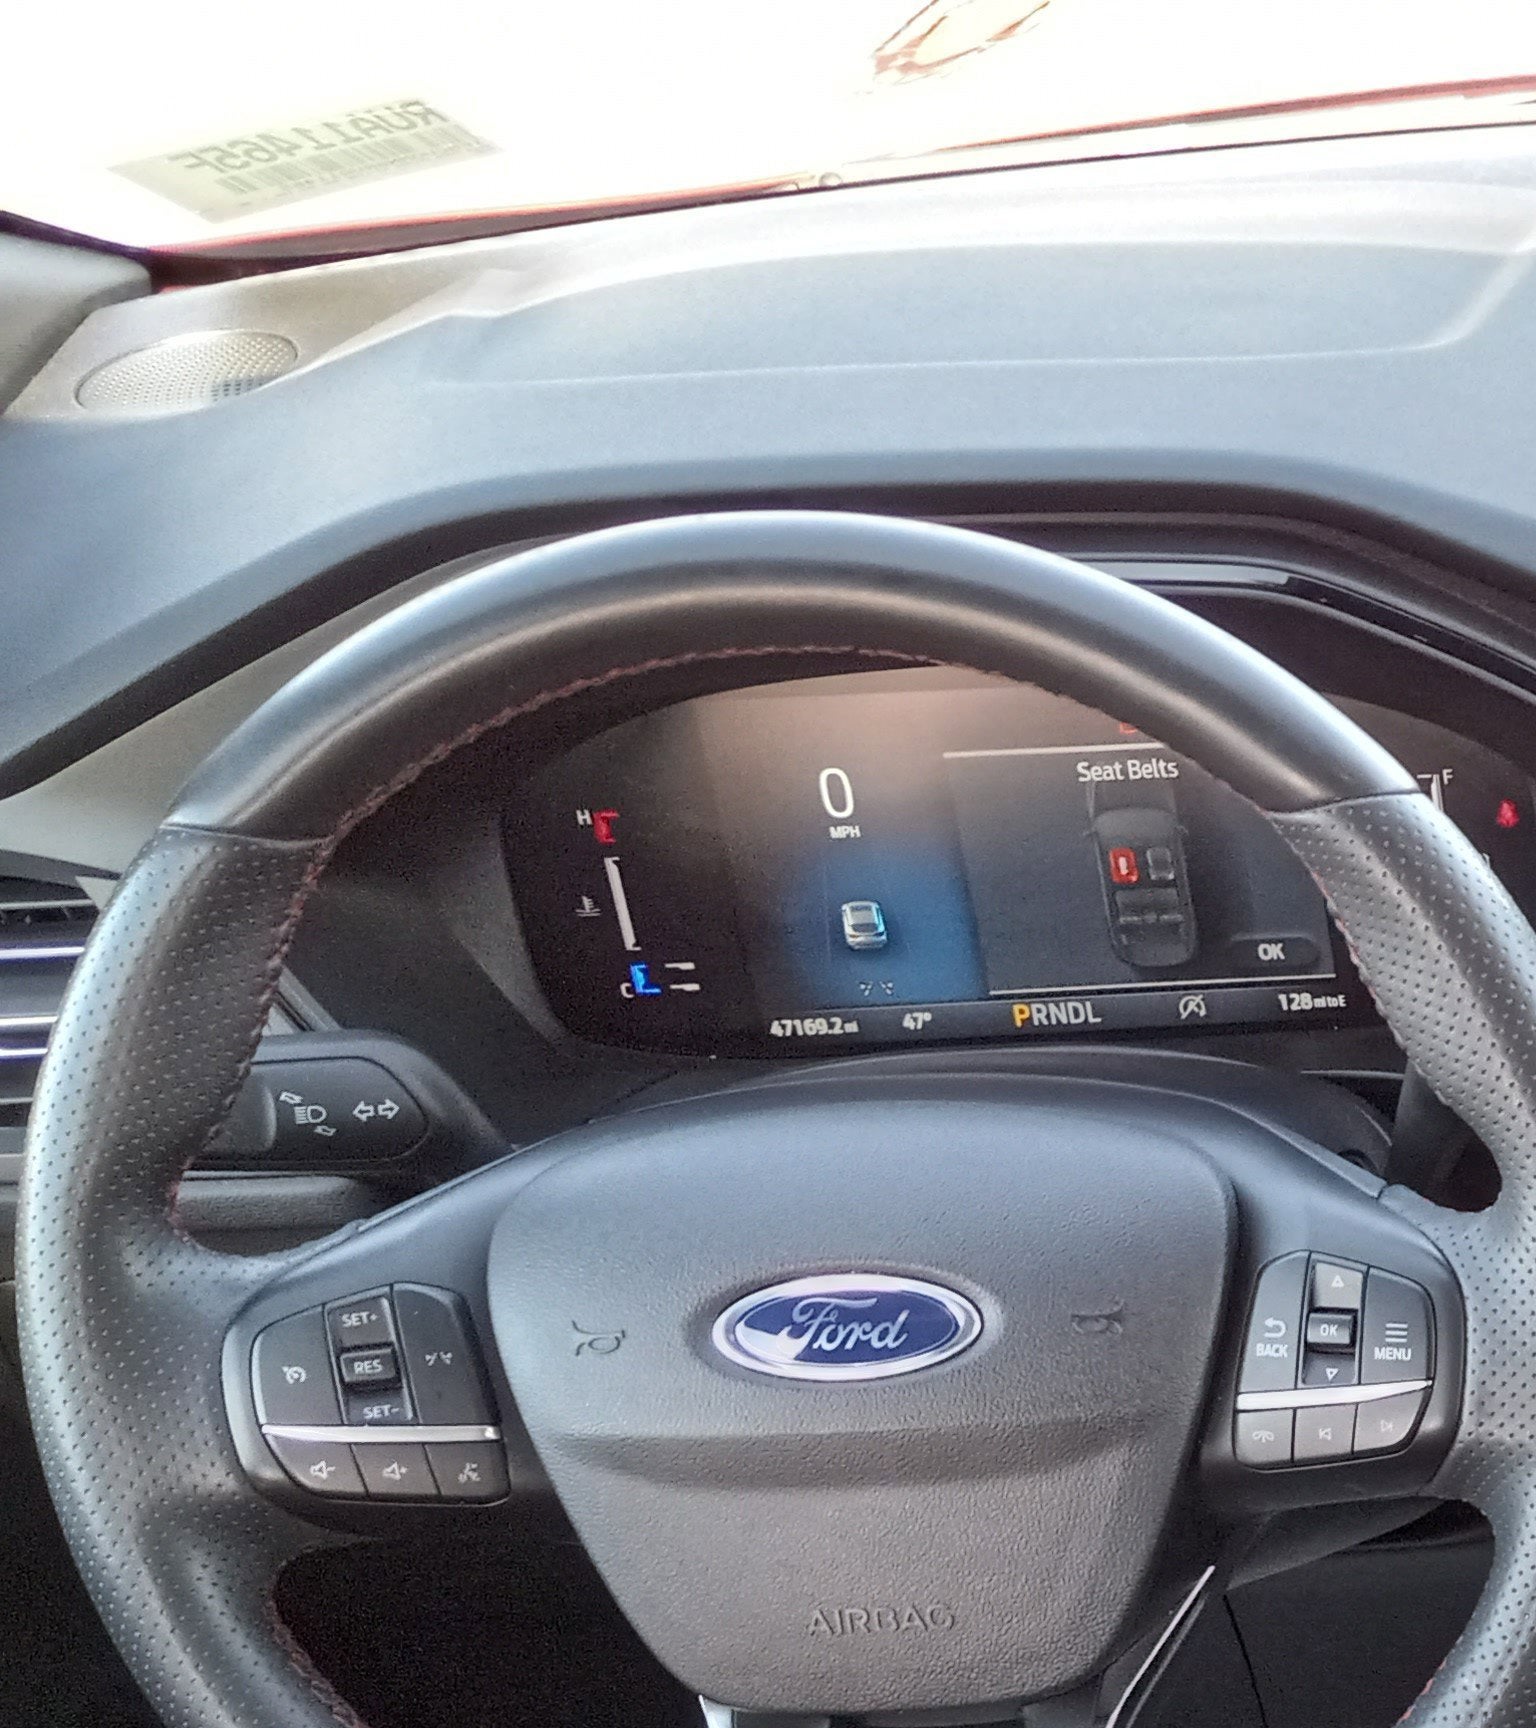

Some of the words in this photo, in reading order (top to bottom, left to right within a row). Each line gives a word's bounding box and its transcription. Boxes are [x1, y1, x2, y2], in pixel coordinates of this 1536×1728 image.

[1077, 761, 1125, 783] Seat
[1126, 757, 1180, 781] Belts
[1442, 768, 1454, 786] F
[818, 766, 855, 819] 0
[576, 809, 593, 826] H
[828, 824, 862, 840] MPH
[1256, 941, 1286, 963] OK
[619, 982, 635, 999] C
[780, 1296, 910, 1355] Ford
[1319, 1324, 1339, 1337] OK
[1255, 1343, 1289, 1359] BACK
[1373, 1346, 1413, 1362] MENU
[352, 1358, 384, 1375] RES
[807, 1602, 958, 1640] AIRBAG
